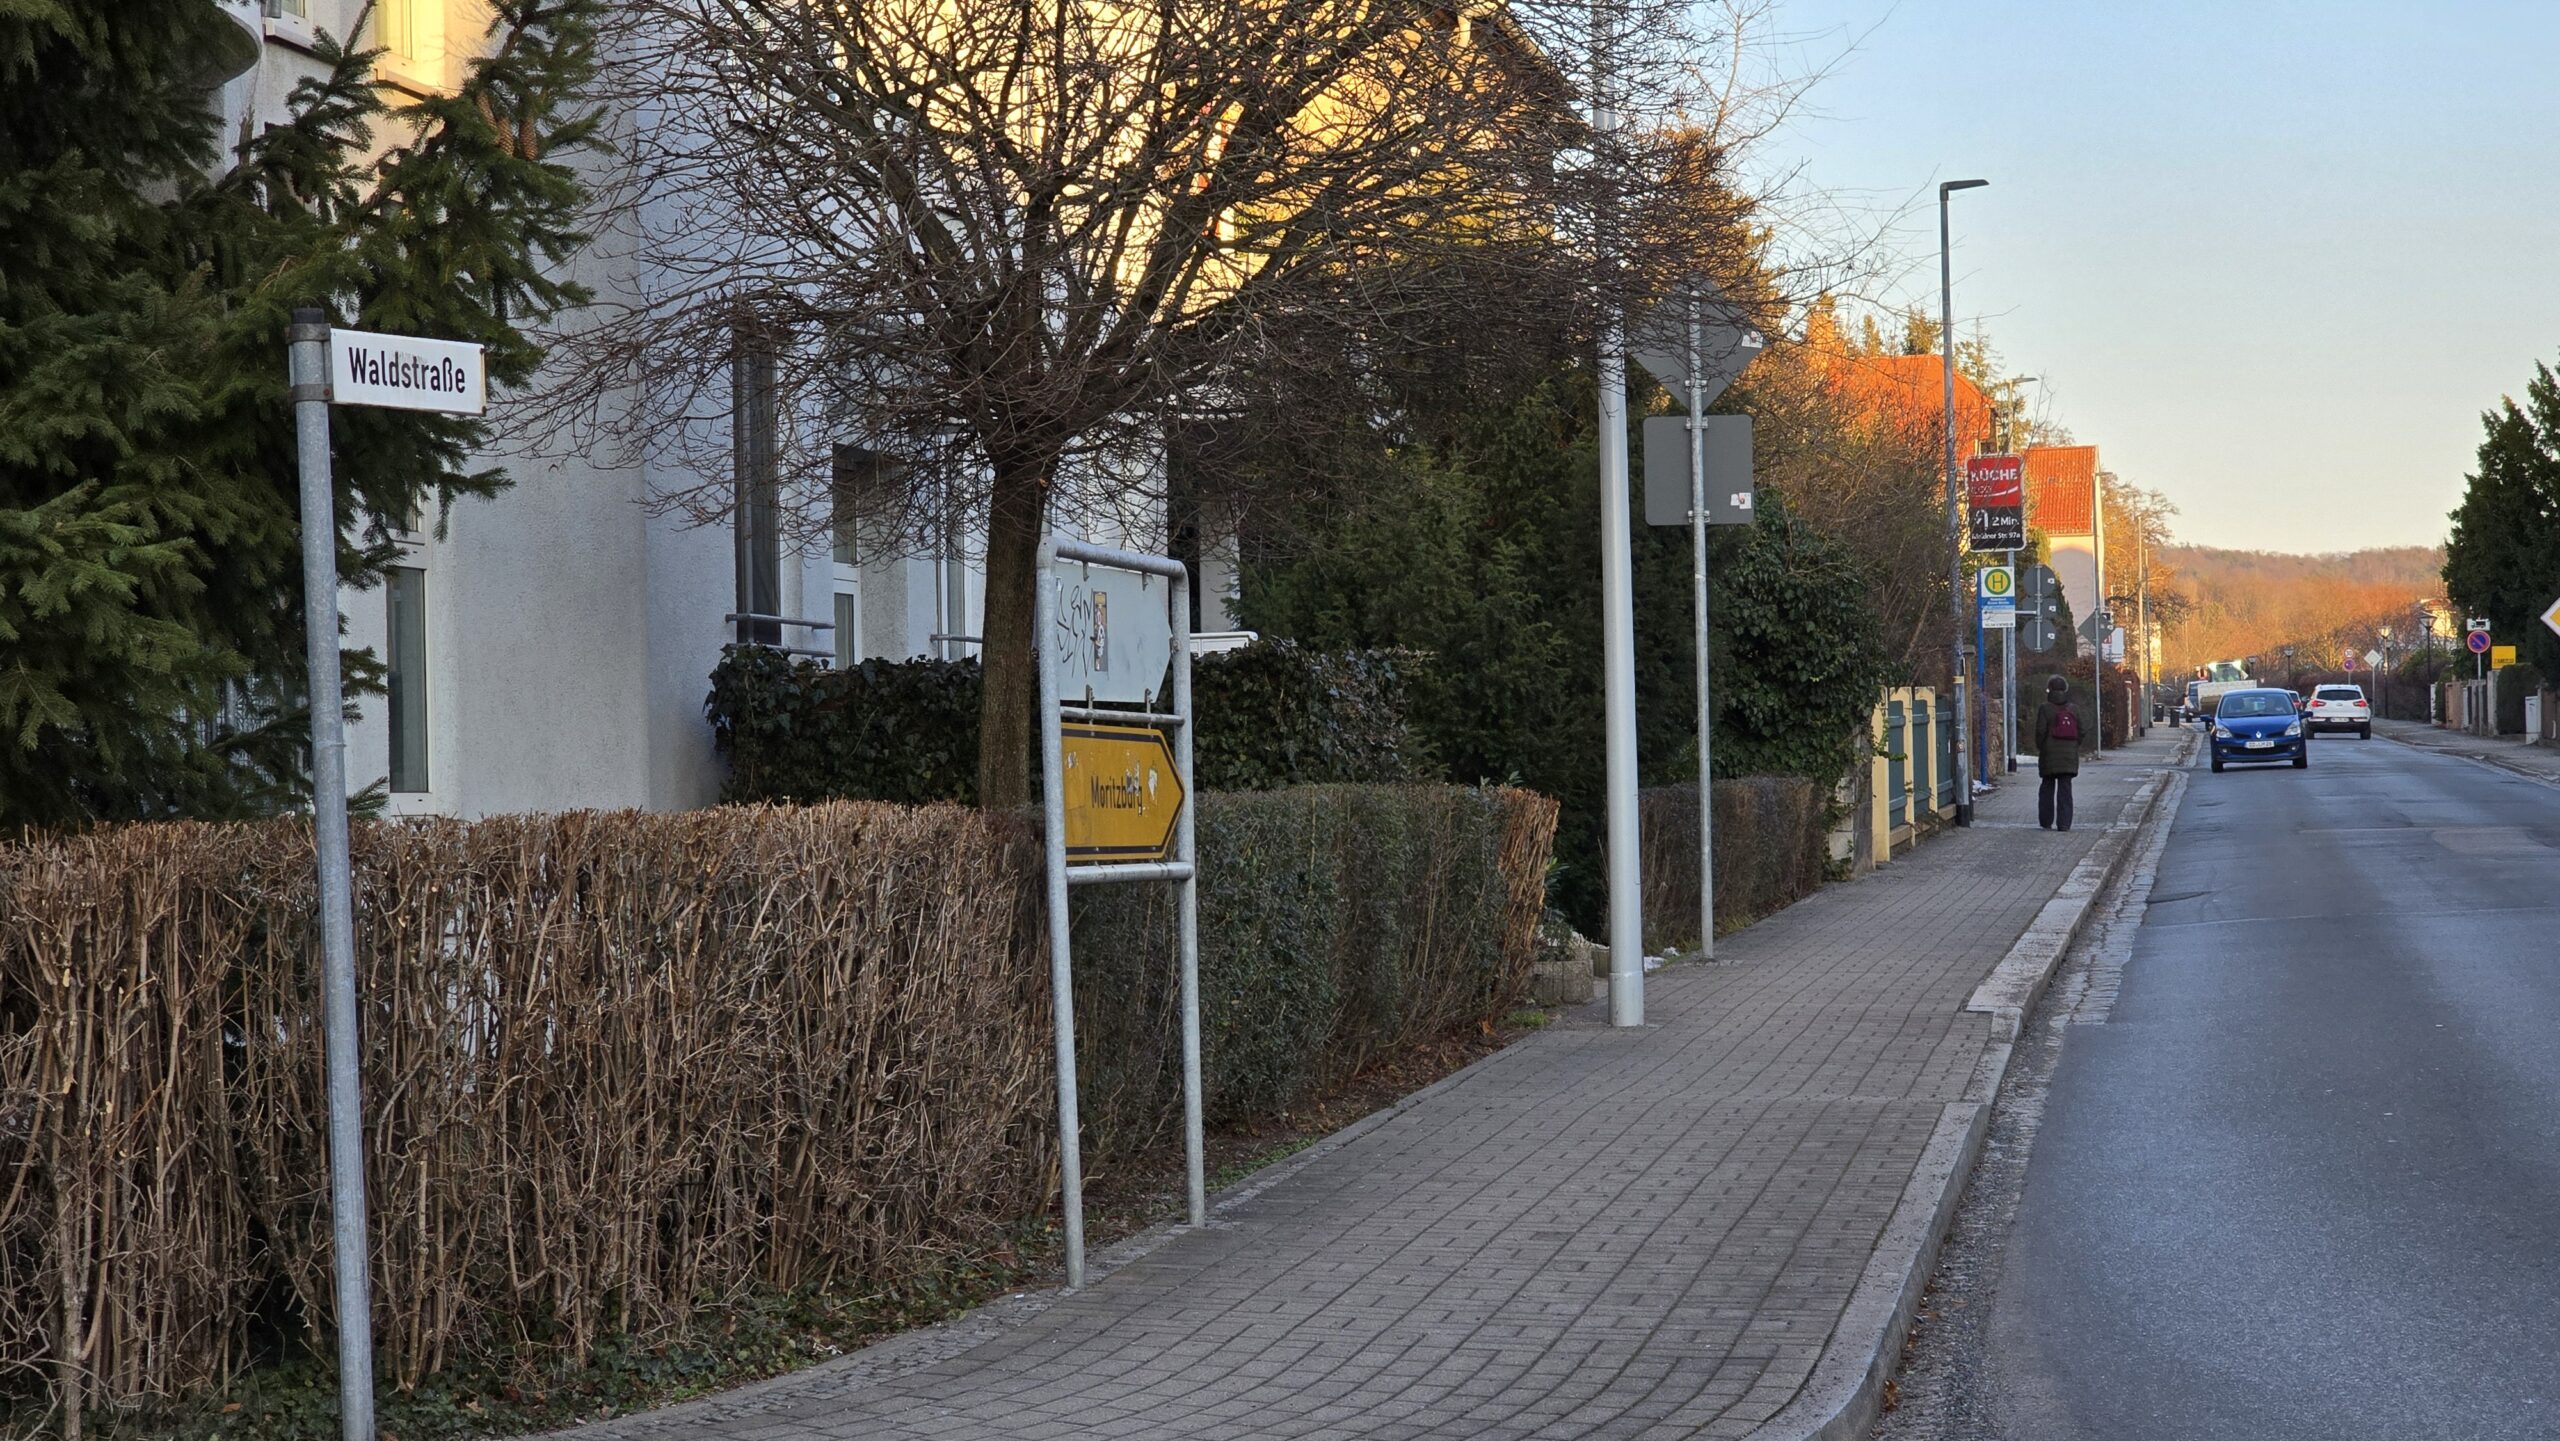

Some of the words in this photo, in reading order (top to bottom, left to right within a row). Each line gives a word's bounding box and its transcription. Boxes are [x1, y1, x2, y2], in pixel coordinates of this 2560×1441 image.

[348, 346, 466, 394] Waldstraße
[1970, 467, 2018, 482] KÜCHE
[1992, 516, 2000, 526] 2
[1992, 574, 2004, 590] H
[1090, 775, 1143, 817] Moritzburg
